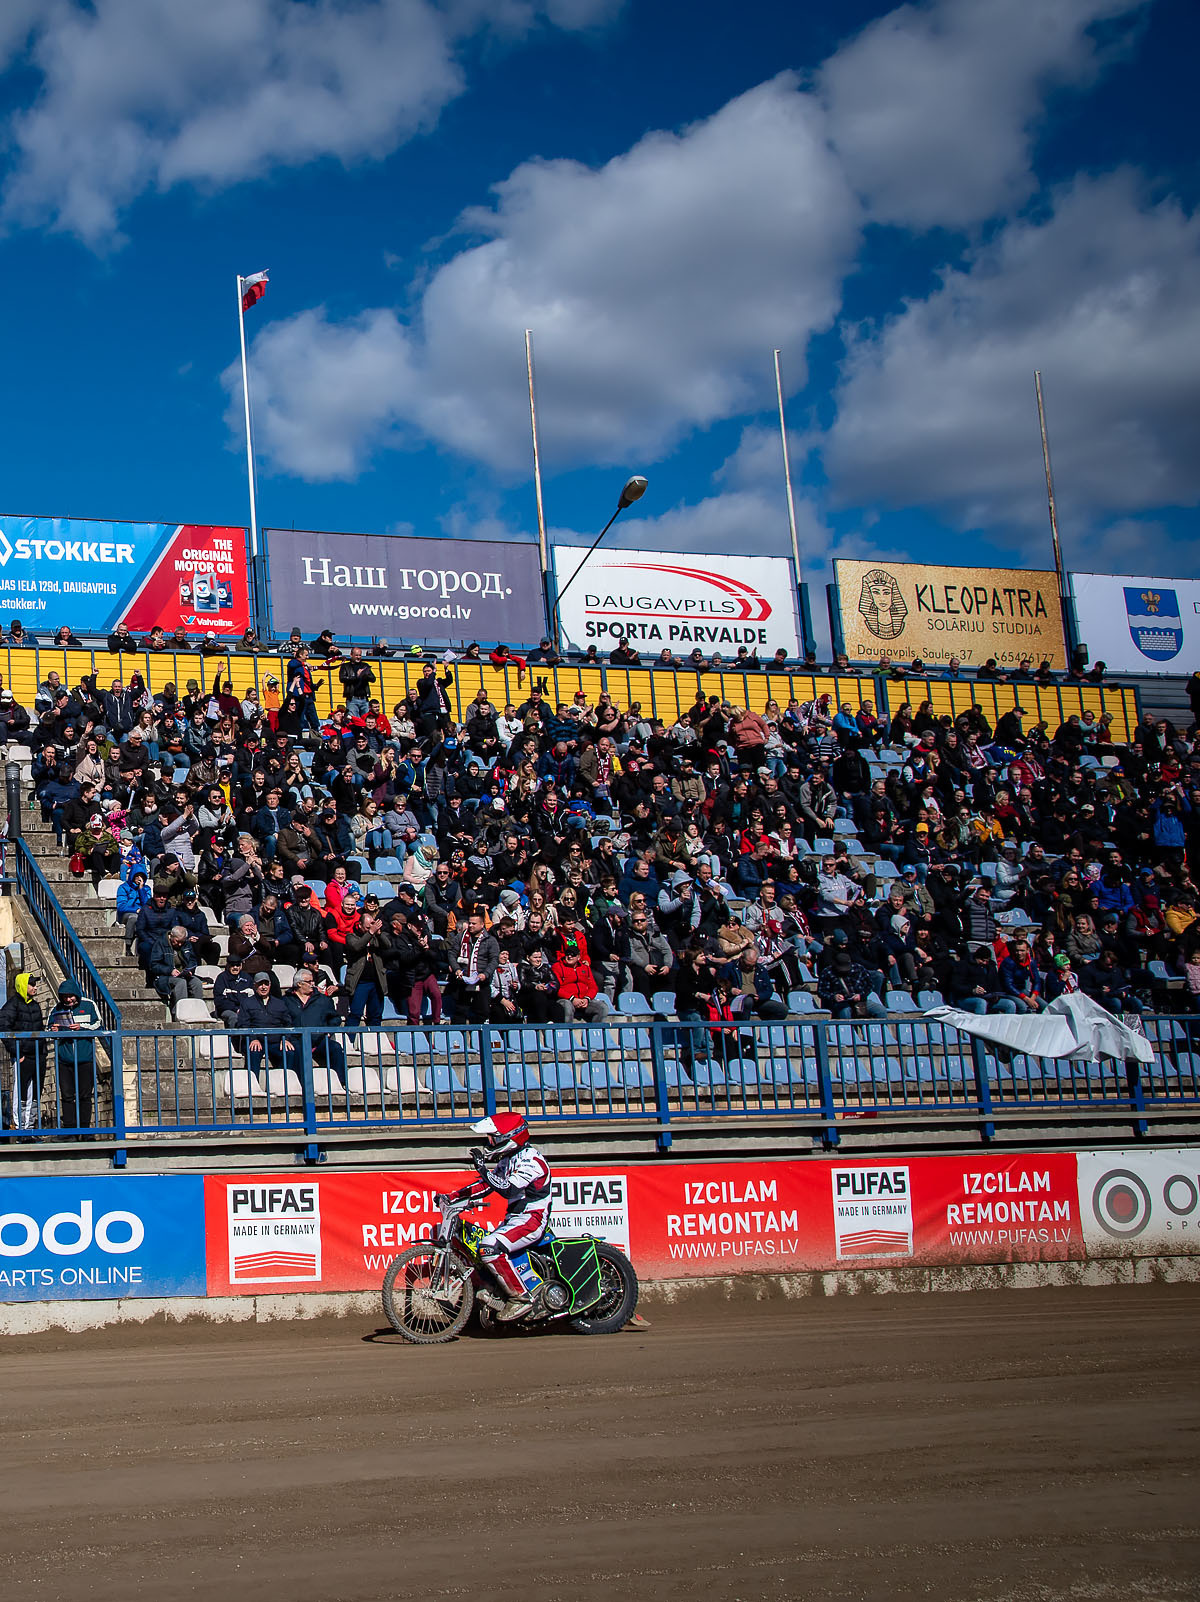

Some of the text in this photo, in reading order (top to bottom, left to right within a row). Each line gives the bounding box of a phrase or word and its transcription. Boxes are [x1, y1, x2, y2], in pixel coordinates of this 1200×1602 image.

[14, 539, 135, 564] STOKKER
[213, 539, 233, 550] THE
[182, 549, 234, 562] ORIGINAL
[174, 560, 234, 574] MOTOR OIL
[18, 580, 37, 592] IELA
[39, 581, 61, 594] 129d,
[63, 582, 117, 595] DAUGAVPILS
[301, 557, 512, 600] Наш город.
[585, 594, 735, 613] DAUGAVPILS
[915, 584, 1048, 618] KLEOPATRA
[349, 603, 472, 619] www.gorod.lv
[585, 620, 767, 644] SPORTA PĀRVALDE
[927, 618, 1042, 635] SOLĀRIJU STUDIJA
[1000, 652, 1055, 663] 65426177
[537, 676, 549, 695] K
[836, 1171, 906, 1196] PUFAS
[963, 1171, 1050, 1194] IZCILAM
[232, 1188, 314, 1213] PUFAS
[551, 1180, 623, 1205] PUFAS
[684, 1180, 777, 1205] IZCILAM
[838, 1204, 907, 1217] MADE IN GERMANY
[947, 1200, 1071, 1225] REMONTAM
[233, 1224, 316, 1237] MADE IN GERMANY
[550, 1215, 623, 1228] MADE IN GERMANY
[667, 1210, 798, 1236] REMONTAM
[949, 1227, 1071, 1246] WWW.PUFAS.LV
[669, 1239, 798, 1259] WWW.PUFAS.LV
[60, 1266, 142, 1285] ONLINE
